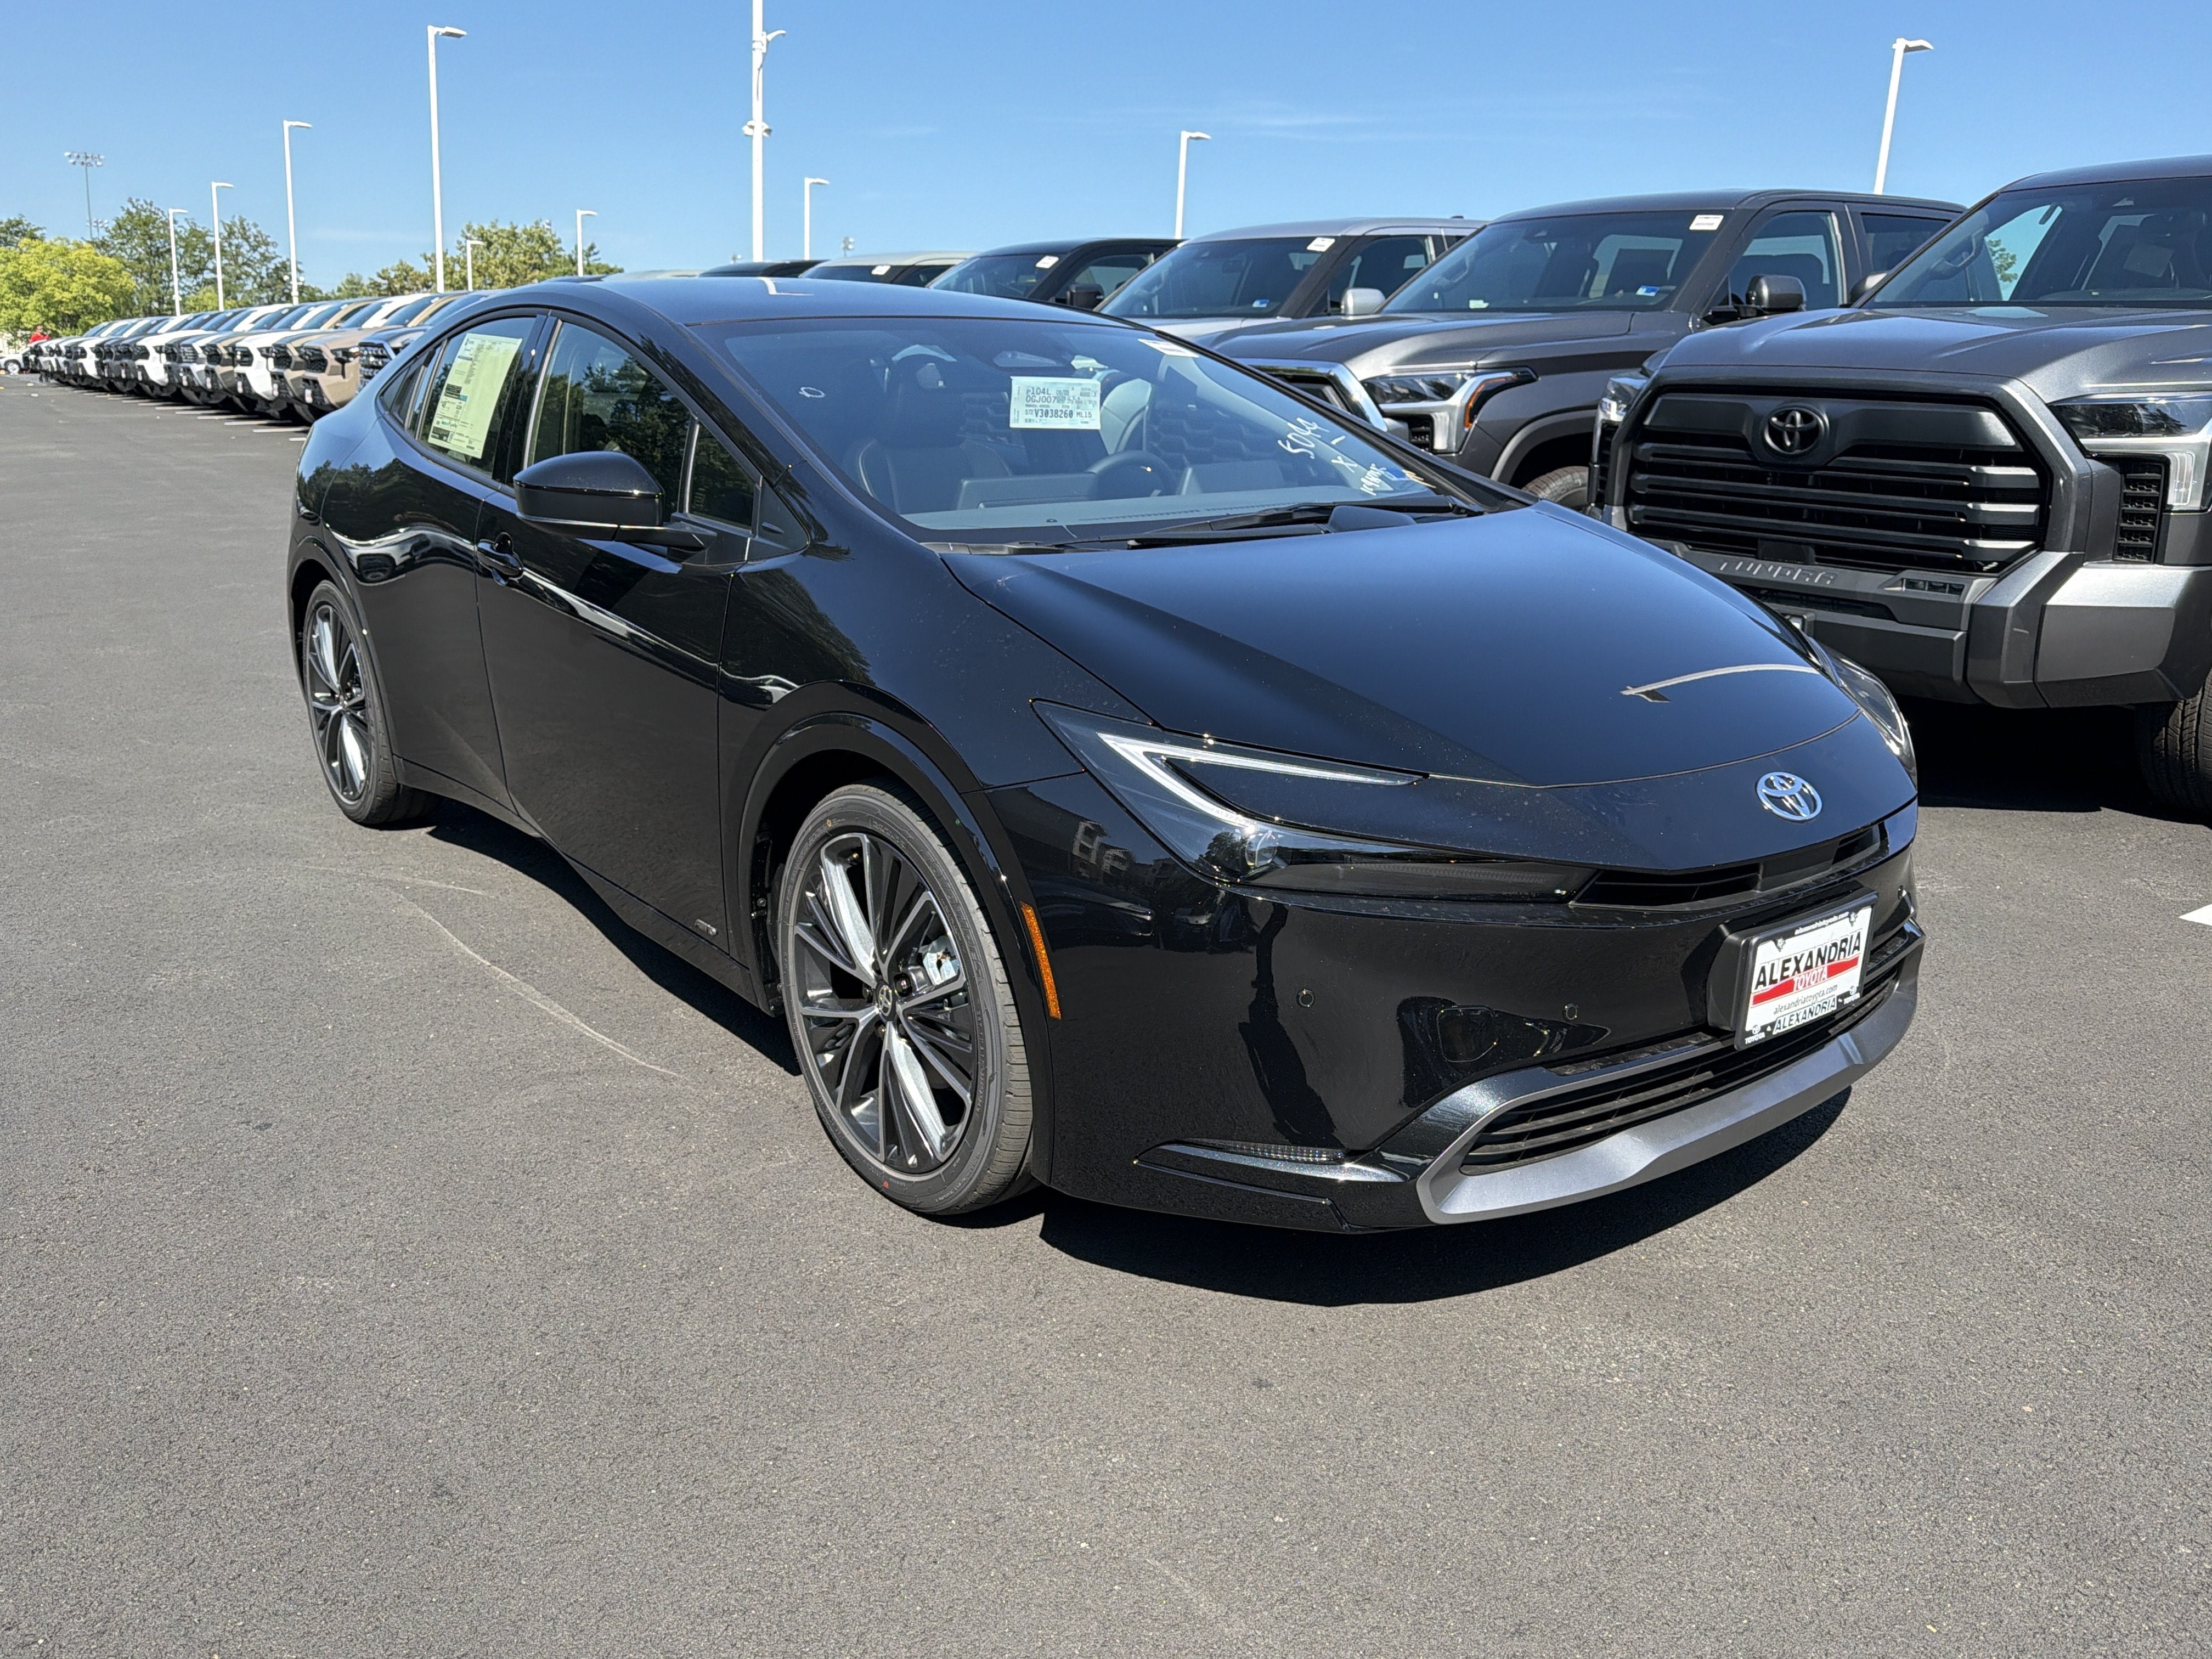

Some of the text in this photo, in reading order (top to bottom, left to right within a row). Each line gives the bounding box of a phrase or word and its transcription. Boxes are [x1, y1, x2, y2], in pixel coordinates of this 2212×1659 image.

[1035, 409, 1074, 418] V3038260
[1719, 561, 1838, 585] TUNDRA
[1755, 931, 1861, 990] ALEXANDRIA
[1793, 968, 1828, 992] TOYOTA
[1773, 984, 1838, 1015] alexandriatoyota.com
[1775, 997, 1836, 1032] ALEXANDRIA
[1745, 1032, 1765, 1045] TOYOTA
